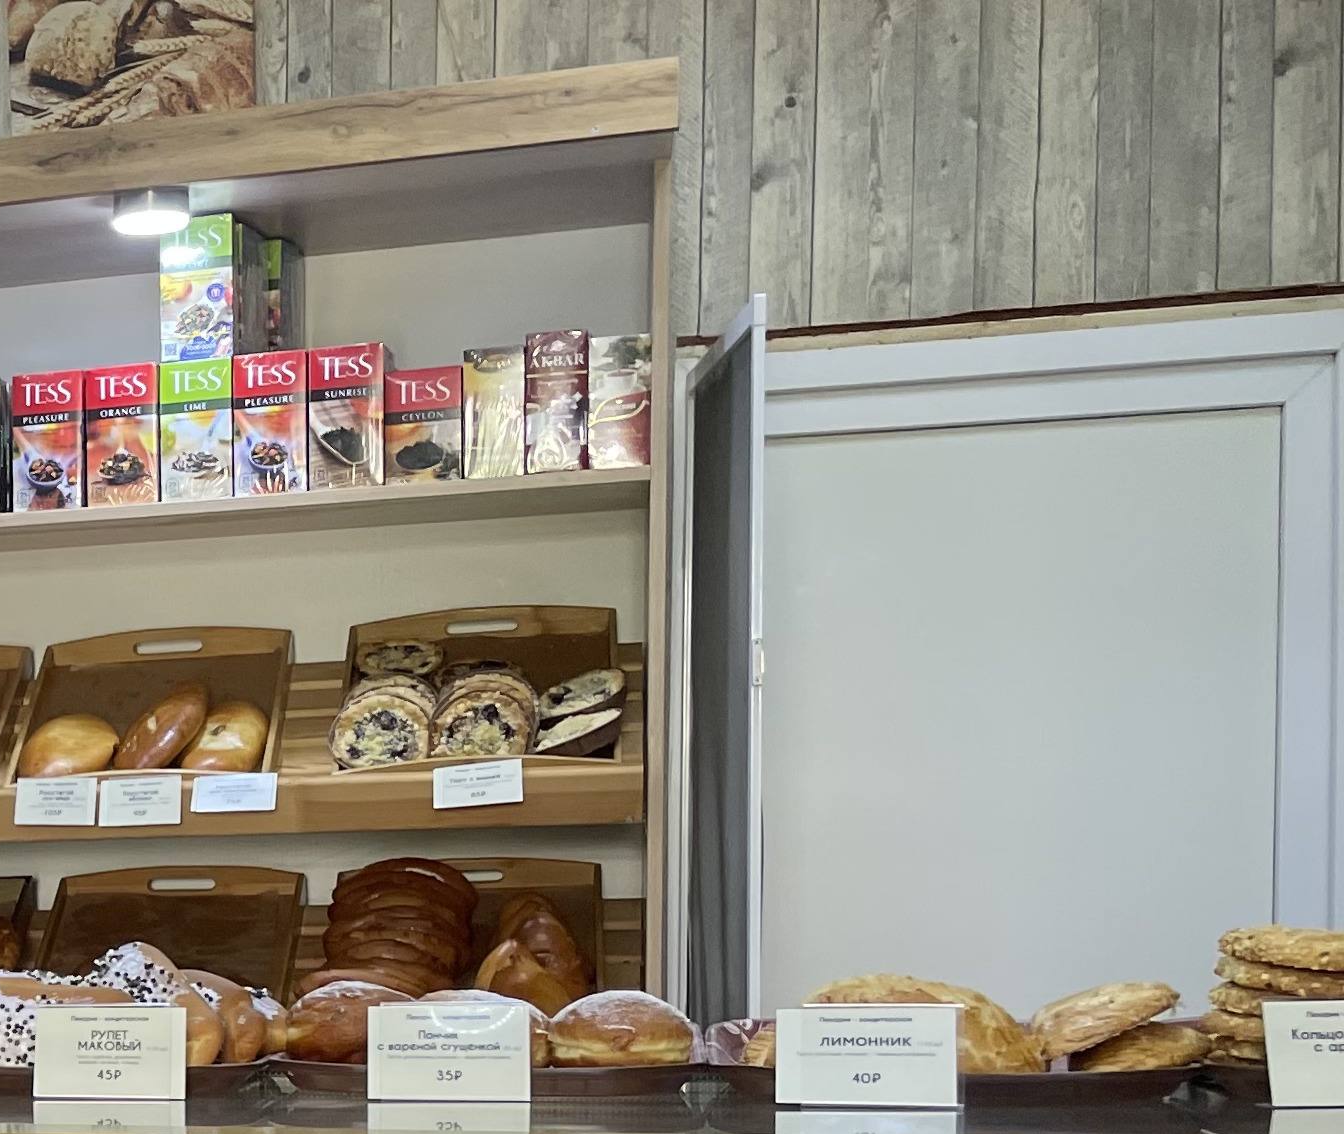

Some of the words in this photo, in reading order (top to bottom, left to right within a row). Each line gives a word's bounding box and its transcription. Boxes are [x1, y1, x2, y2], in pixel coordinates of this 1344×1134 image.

[318, 352, 373, 382] TESS
[529, 352, 585, 370] AKBAR
[169, 365, 224, 395] TESS
[242, 359, 297, 390] TESS
[95, 372, 148, 401] TESS
[397, 375, 451, 406] TESS
[21, 379, 72, 407] TESS
[324, 387, 368, 399] SUNRISE
[183, 401, 208, 412] LIME
[244, 394, 294, 408] PLEASURE
[22, 412, 69, 424] PLEASURE
[99, 406, 142, 418] ORANGE
[401, 410, 445, 422] CEYLON
[91, 1030, 129, 1041] РУЛЕТ
[418, 1029, 459, 1040] Пончик
[1291, 1028, 1344, 1041] Кольцо
[77, 1039, 142, 1051] МАКОВЫЙ
[377, 1043, 385, 1051] с
[388, 1042, 437, 1052] вареной
[440, 1041, 502, 1051] сгущенкой
[819, 1036, 912, 1047] ЛИМОННИК
[1313, 1043, 1324, 1052] с
